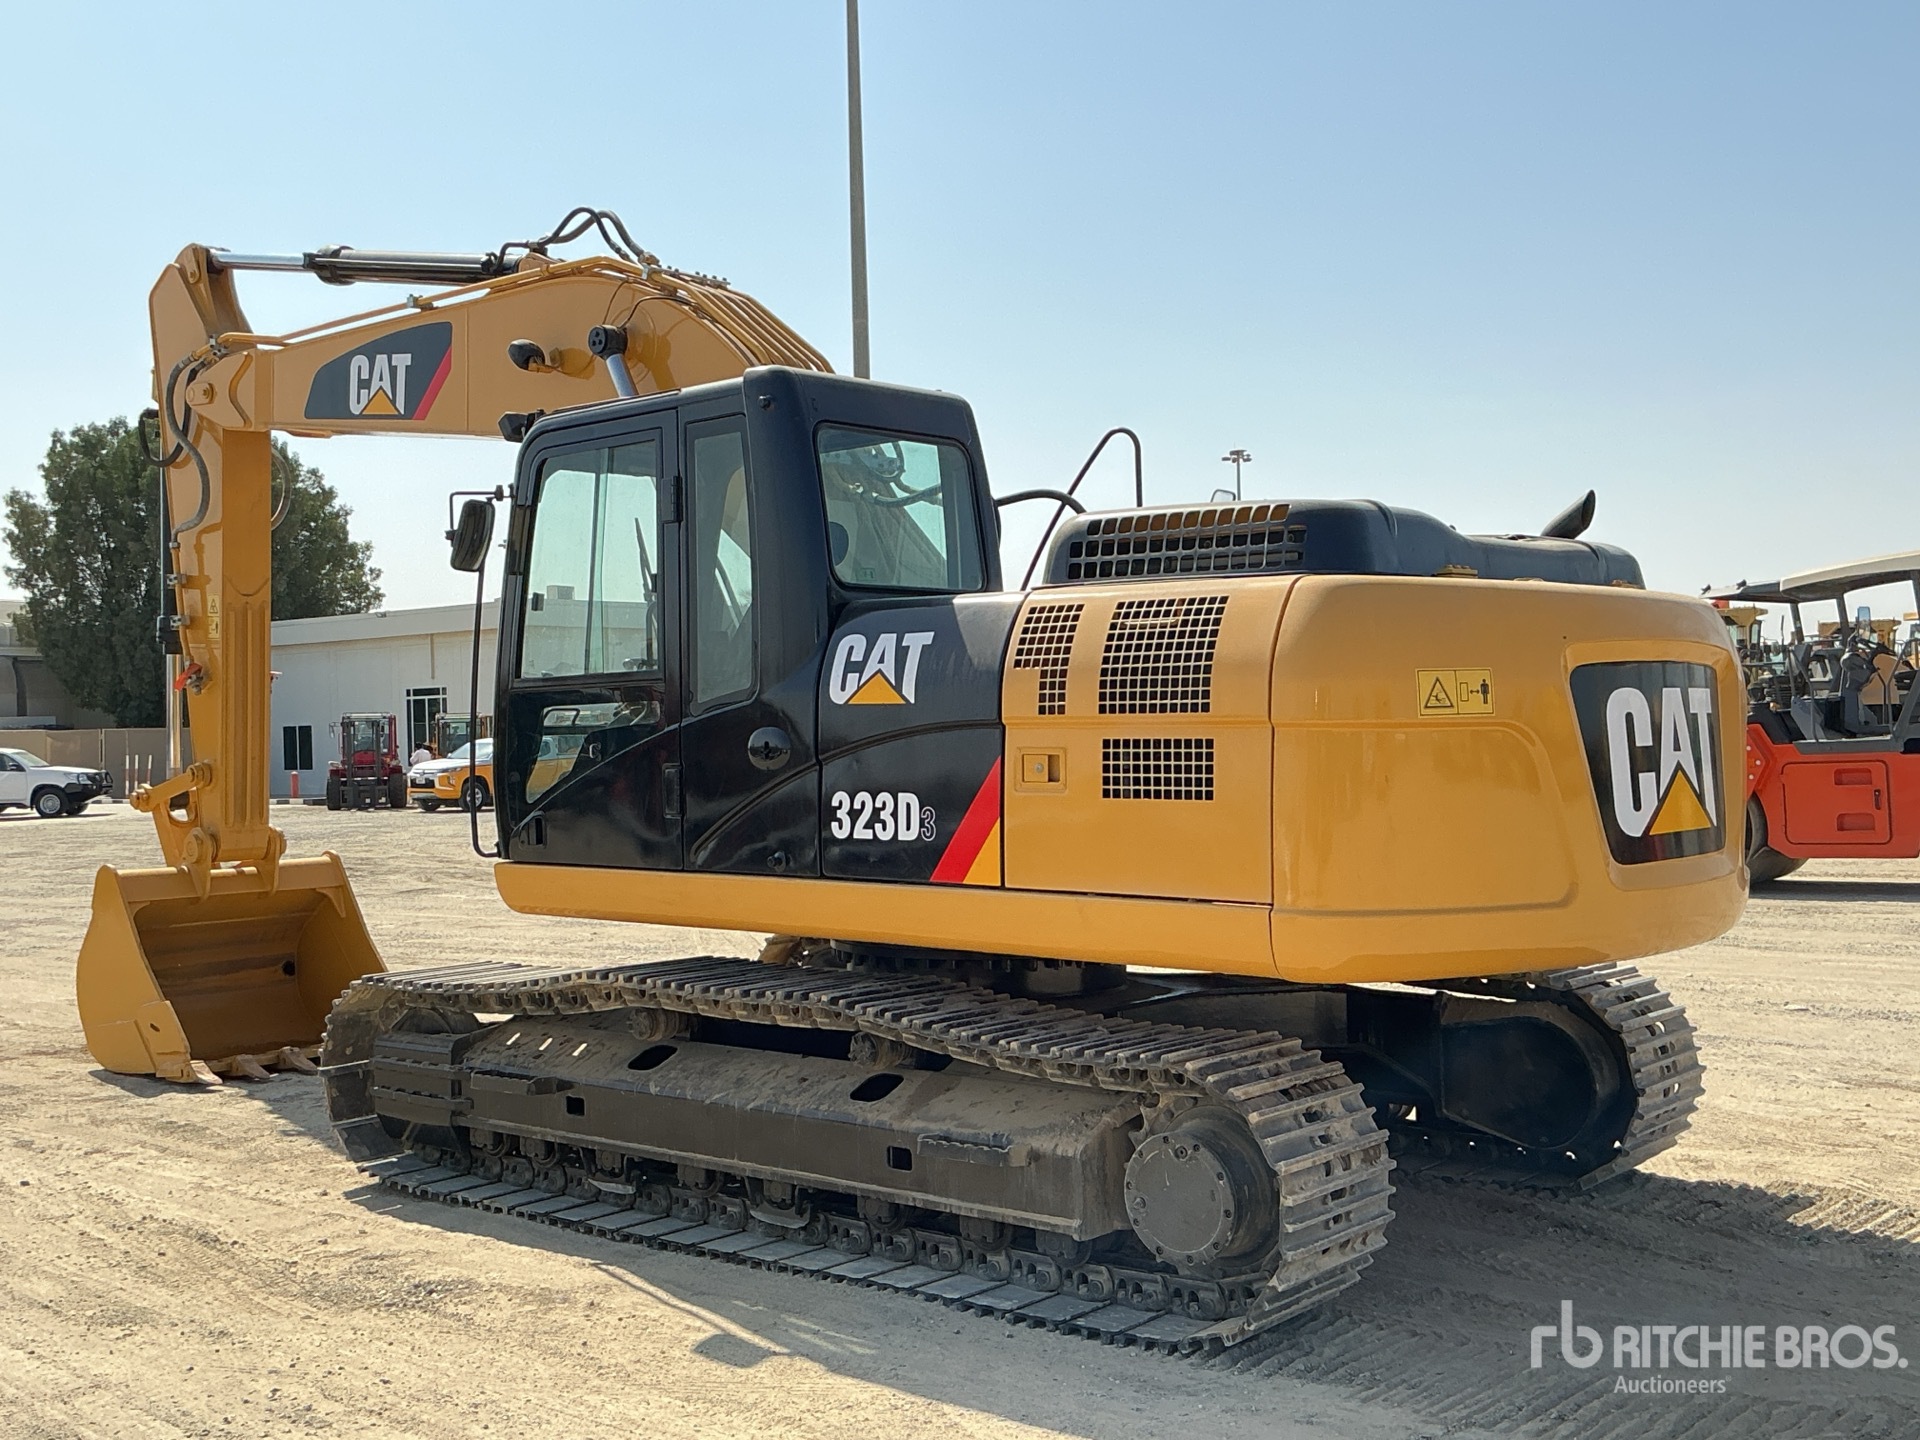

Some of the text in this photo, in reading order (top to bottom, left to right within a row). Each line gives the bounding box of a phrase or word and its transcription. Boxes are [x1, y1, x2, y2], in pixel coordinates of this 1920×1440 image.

[350, 353, 412, 415] CAT
[829, 631, 935, 705] CAT
[1606, 687, 1717, 838] CAT
